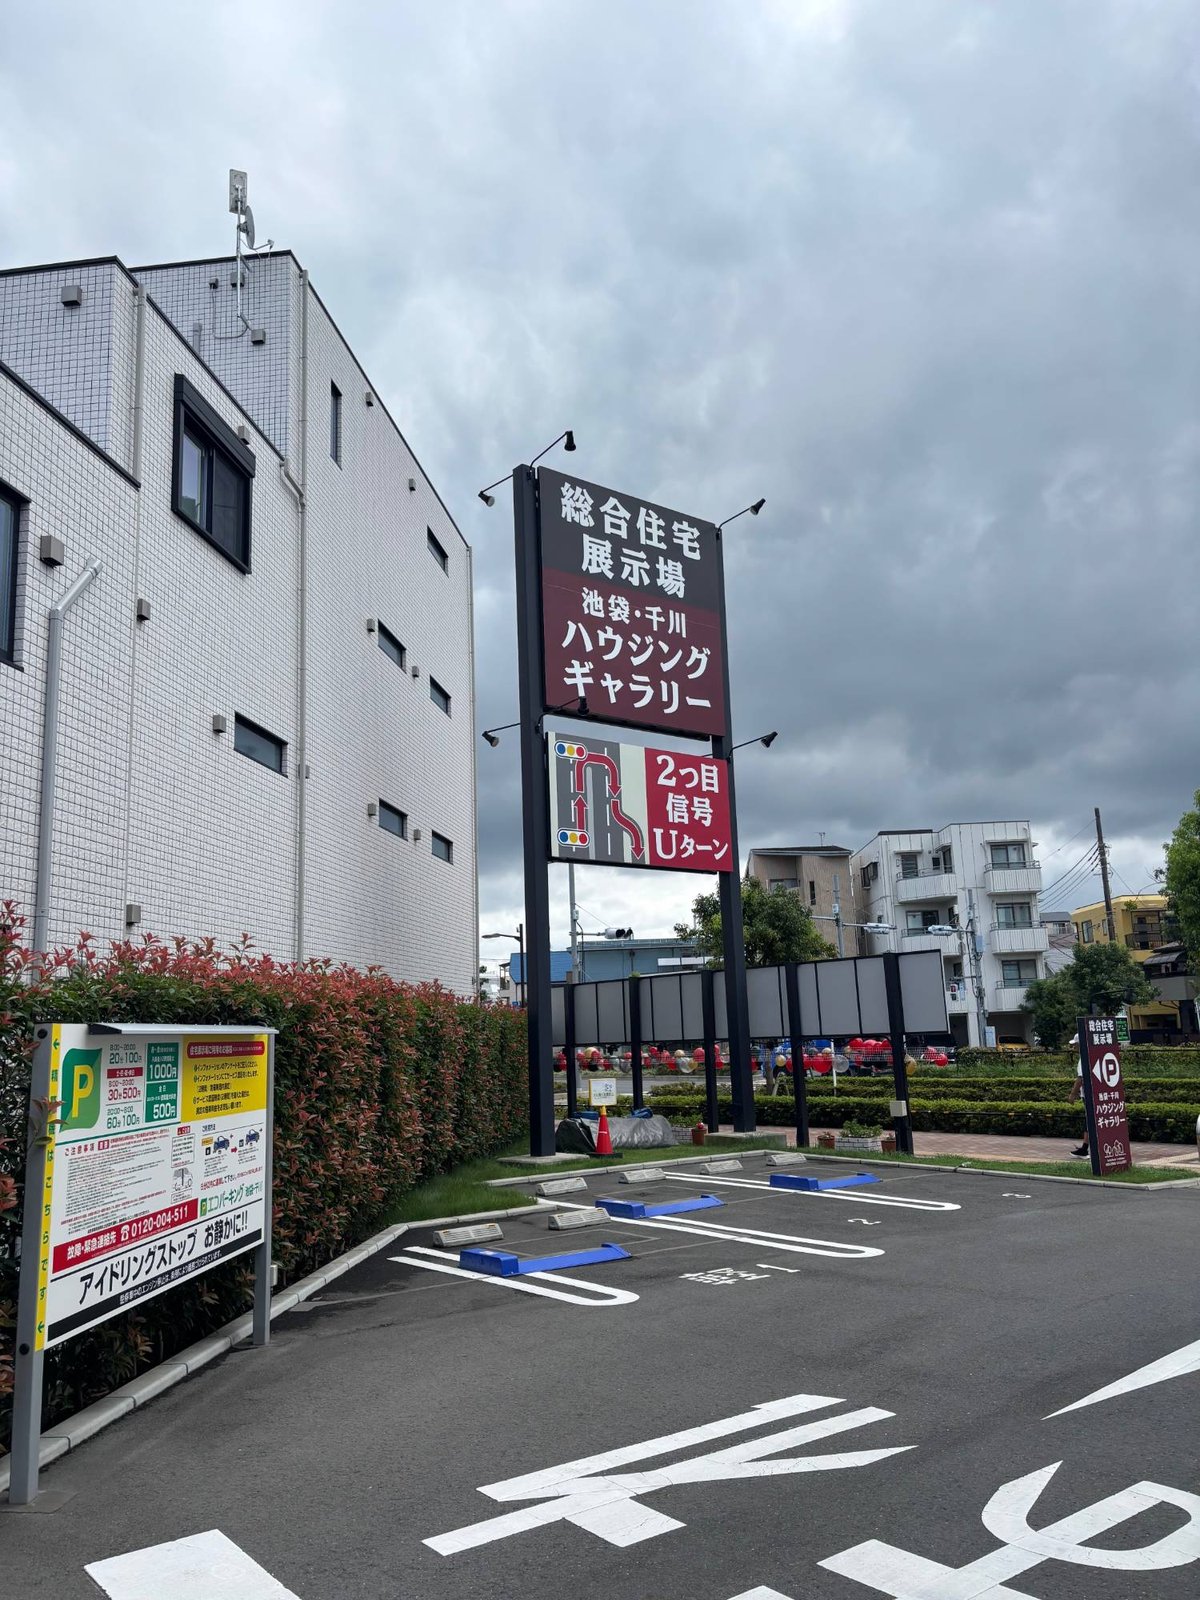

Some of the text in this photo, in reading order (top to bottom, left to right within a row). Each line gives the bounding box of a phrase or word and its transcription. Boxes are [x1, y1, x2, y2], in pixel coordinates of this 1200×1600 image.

[560, 481, 701, 561] 総合住宅
[581, 533, 686, 599] 展示場
[582, 586, 687, 638] 池袋・千川
[562, 619, 711, 680] ハウジング
[563, 659, 711, 715] ギャラリー
[656, 754, 720, 793] 2つ目
[665, 793, 713, 827] 信号
[653, 828, 729, 861] Uターン
[1088, 1019, 1114, 1032] 総合住宅
[1092, 1033, 1113, 1045] 展示場
[149, 1063, 177, 1080] 1000円
[72, 1065, 95, 1118] P
[1096, 1101, 1126, 1115] ハウジング
[153, 1101, 177, 1119] 500円
[1097, 1116, 1126, 1129] ギャラリー
[207, 1183, 244, 1213] エコパーキング
[131, 1206, 189, 1238] 0120-004-511
[847, 1217, 882, 1226] 2
[79, 1230, 197, 1305] アイドリングストップ
[204, 1209, 248, 1249] お静かに!!
